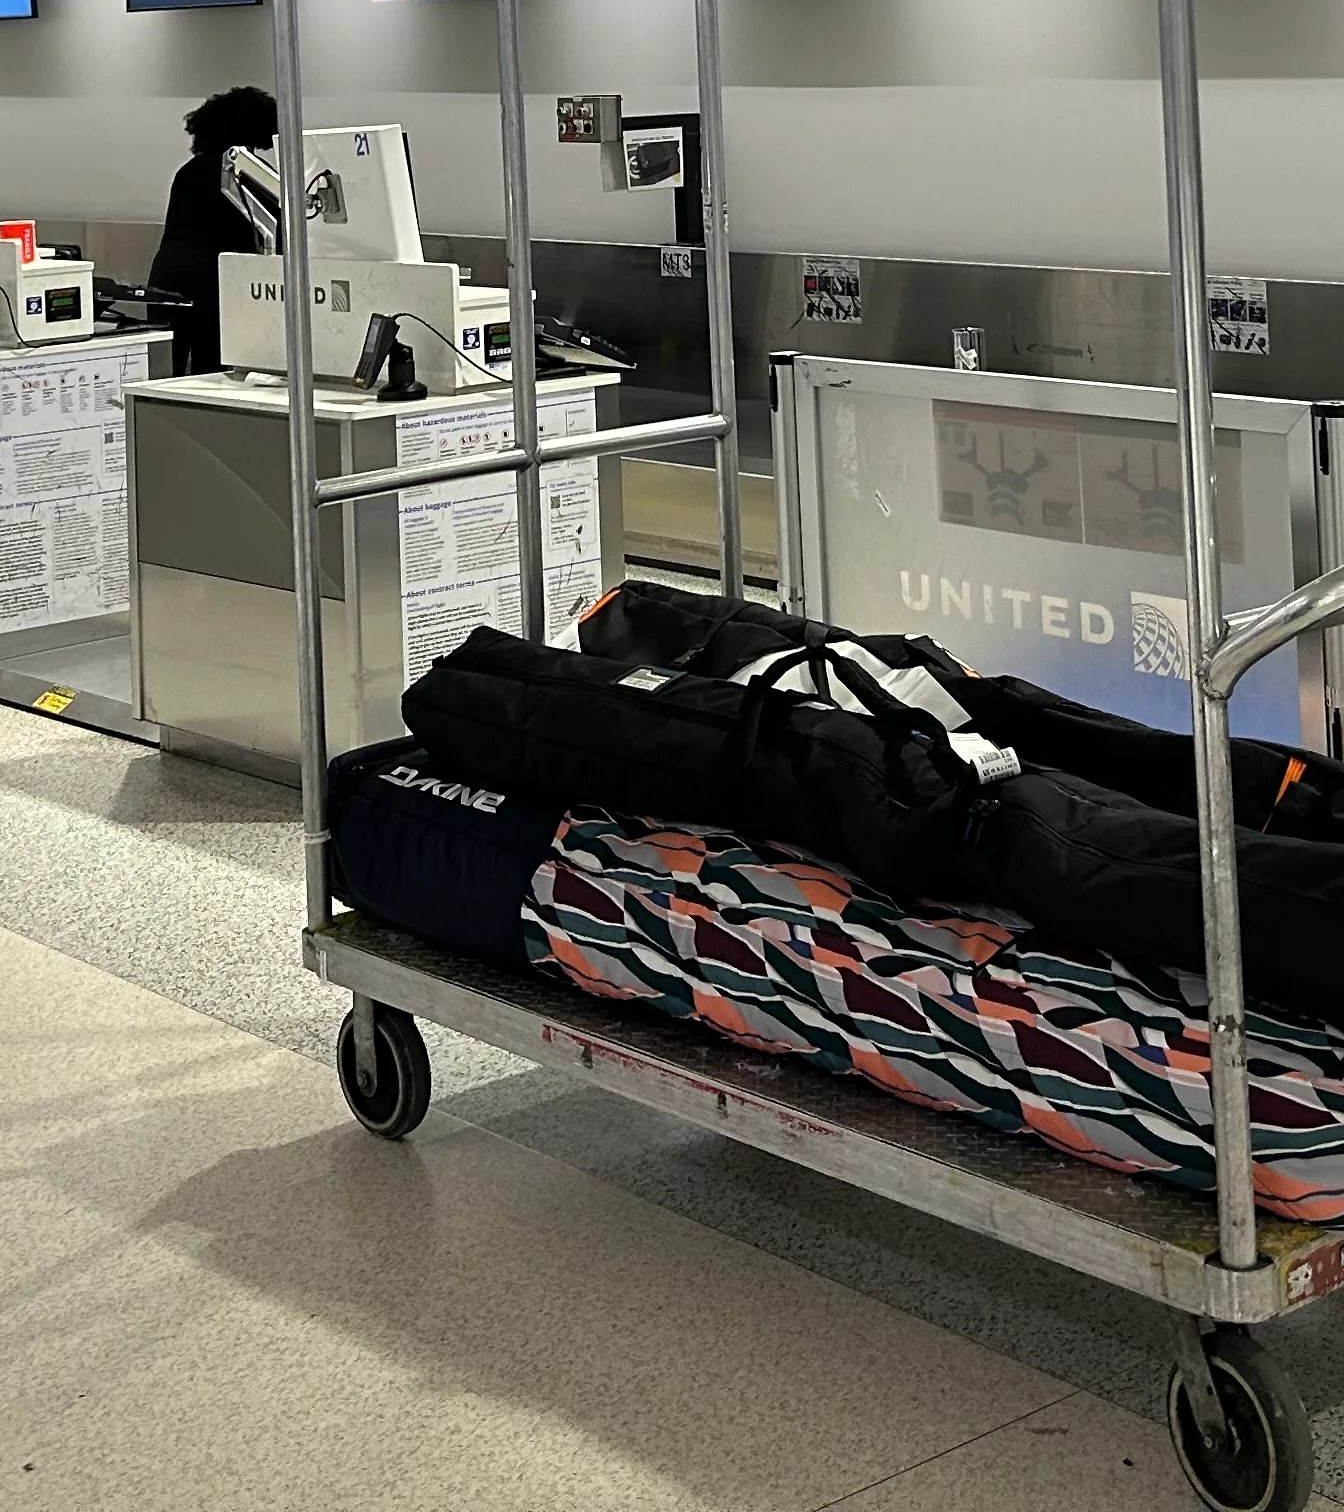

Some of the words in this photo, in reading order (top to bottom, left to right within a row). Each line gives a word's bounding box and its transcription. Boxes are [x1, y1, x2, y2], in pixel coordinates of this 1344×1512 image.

[353, 132, 371, 157] 21
[249, 282, 327, 306] UNID
[401, 420, 421, 430] About
[422, 416, 456, 427] hazardous
[406, 589, 426, 599] About
[427, 584, 455, 594] contract
[456, 580, 475, 589] terms
[899, 570, 1115, 645] UNITED
[377, 765, 506, 815] DAKINE
